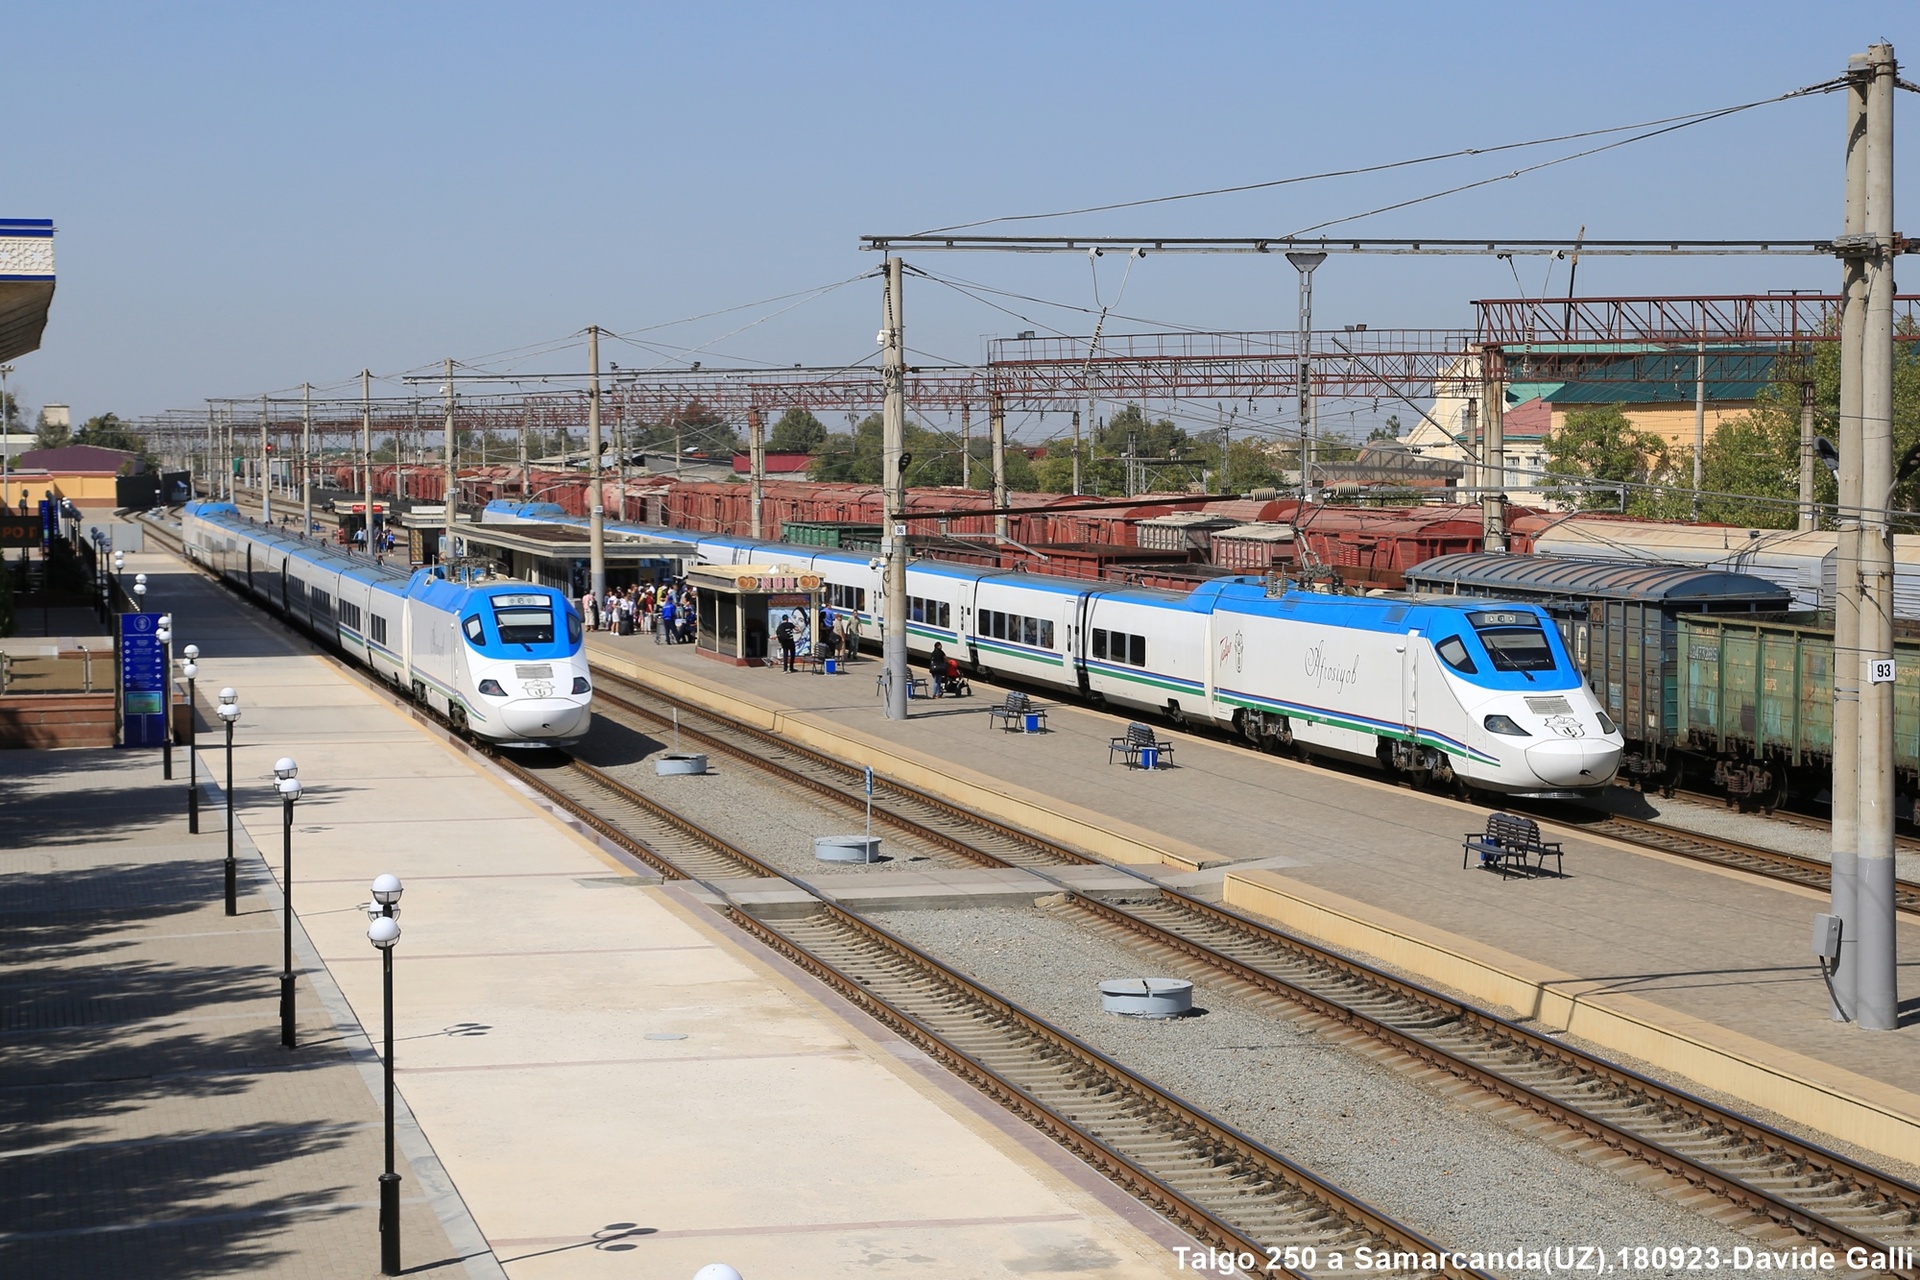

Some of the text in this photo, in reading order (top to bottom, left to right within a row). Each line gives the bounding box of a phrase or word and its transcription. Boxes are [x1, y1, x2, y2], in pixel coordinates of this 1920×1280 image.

[761, 576, 794, 590] NON
[1304, 639, 1360, 695] Afrosiyob
[1877, 663, 1891, 678] 93
